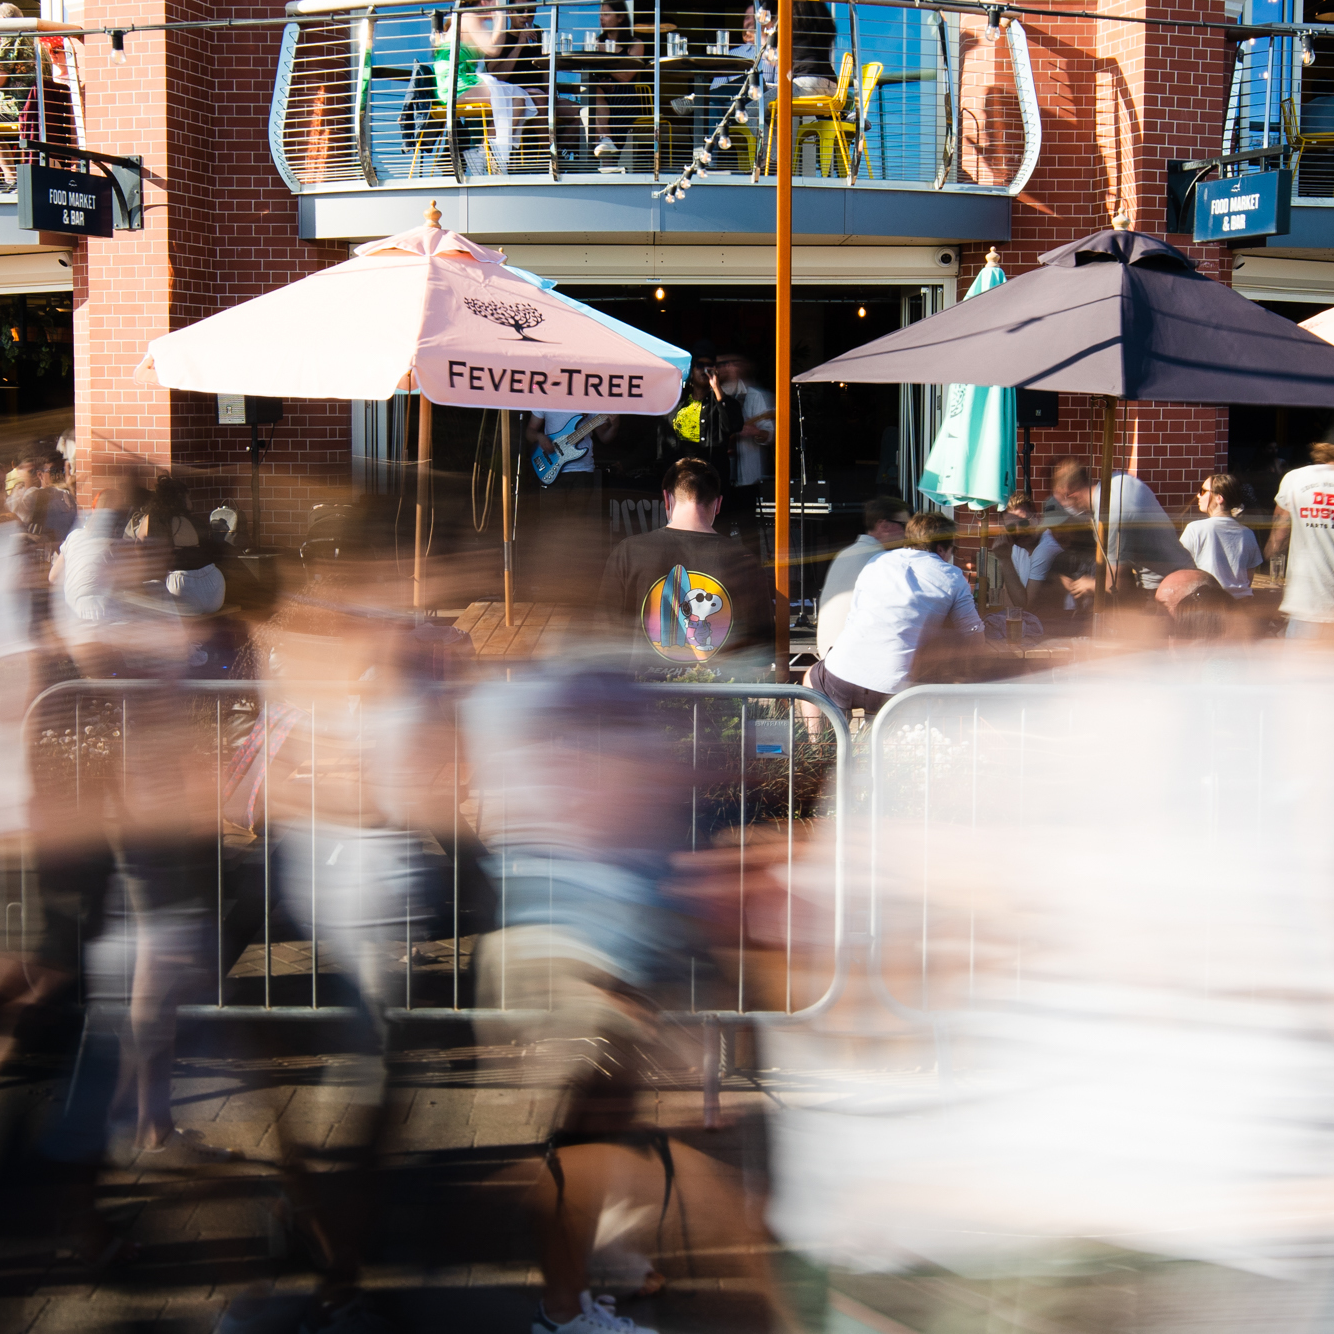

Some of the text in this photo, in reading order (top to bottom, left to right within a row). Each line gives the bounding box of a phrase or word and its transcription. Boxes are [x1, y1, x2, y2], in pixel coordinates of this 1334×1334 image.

[49, 189, 96, 209] FOOD MARKET
[1211, 194, 1260, 215] FOOD MARKET
[62, 209, 85, 226] & BAR
[1222, 214, 1246, 231] & BAR
[447, 360, 644, 398] FEVER-TREE
